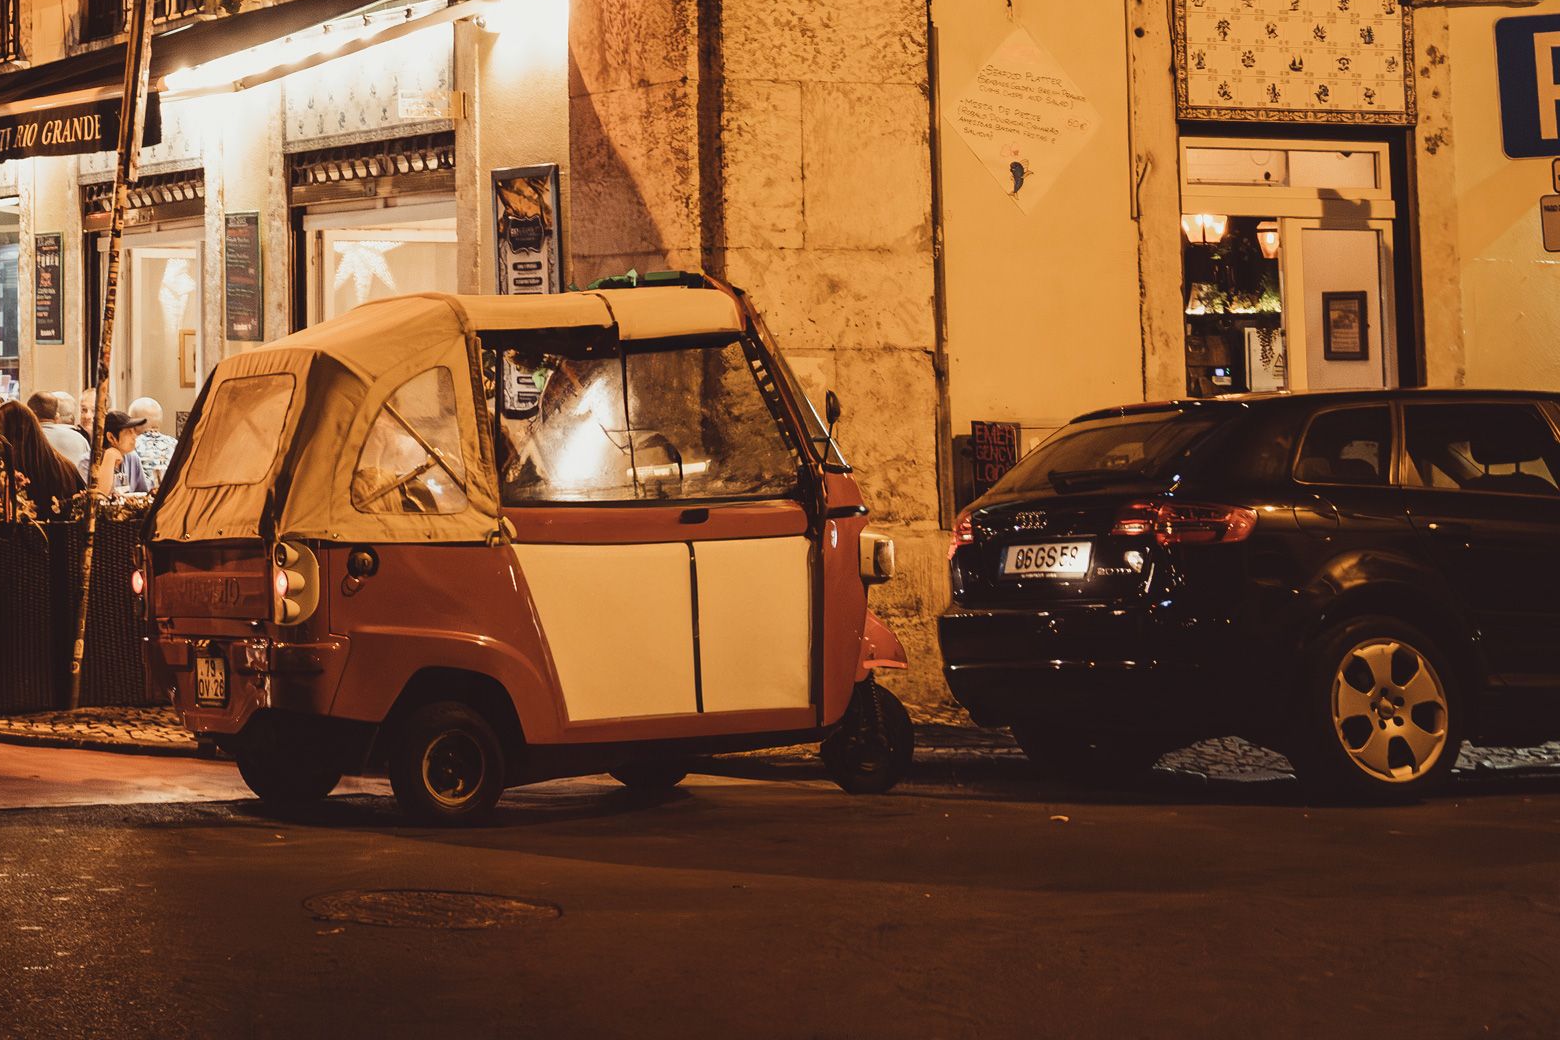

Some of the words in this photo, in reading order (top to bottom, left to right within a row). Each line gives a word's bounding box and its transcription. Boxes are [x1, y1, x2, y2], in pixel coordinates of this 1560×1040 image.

[13, 123, 38, 148] RIO
[41, 114, 102, 146] GRANDE
[204, 659, 217, 676] 79
